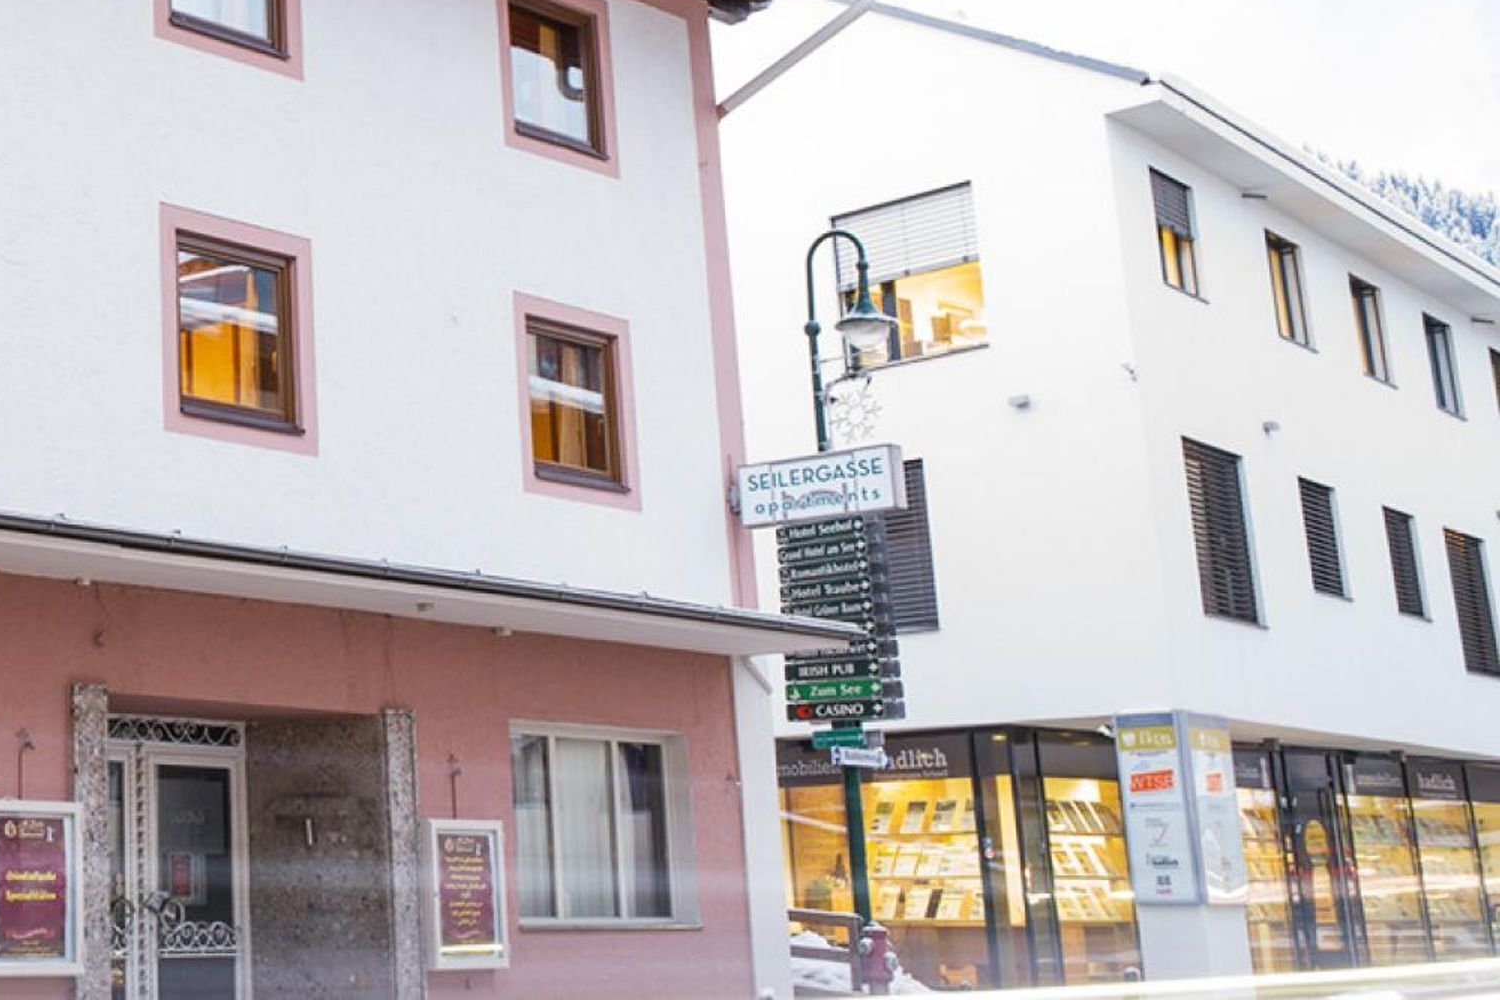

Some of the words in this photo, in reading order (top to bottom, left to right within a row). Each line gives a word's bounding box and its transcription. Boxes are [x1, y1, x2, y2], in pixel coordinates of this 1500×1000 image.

[748, 458, 883, 491] SEILERGASSE
[756, 487, 880, 515] apartments
[798, 664, 828, 677] IRISH
[831, 662, 855, 675] PUB
[810, 685, 837, 697] Zum
[840, 682, 862, 696] See
[815, 702, 864, 717] CASINO
